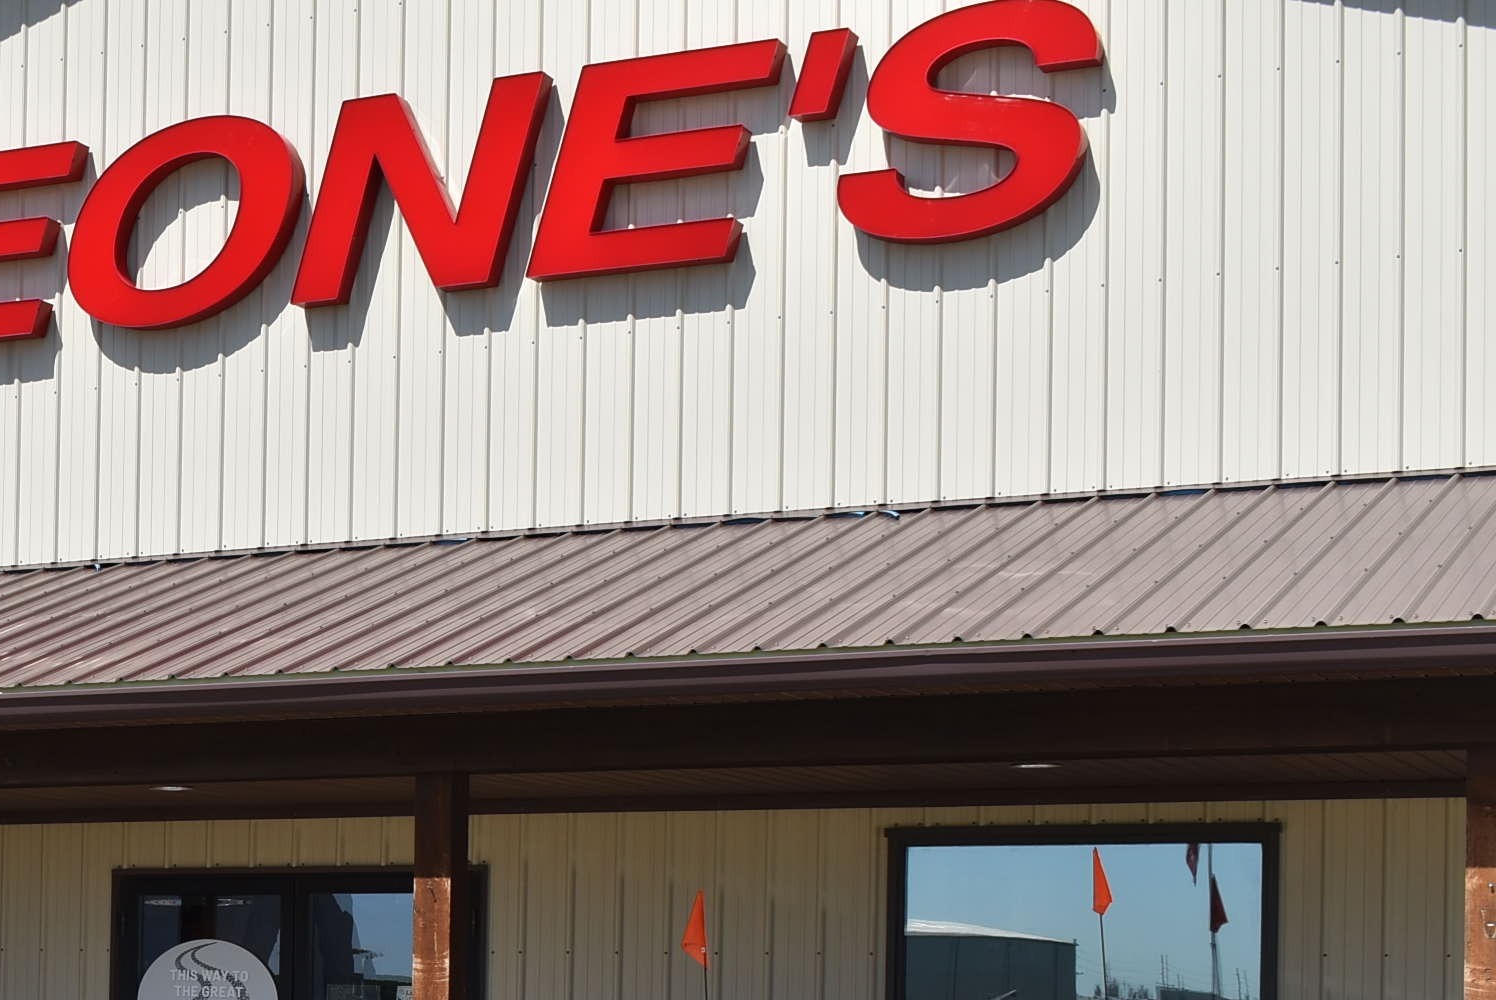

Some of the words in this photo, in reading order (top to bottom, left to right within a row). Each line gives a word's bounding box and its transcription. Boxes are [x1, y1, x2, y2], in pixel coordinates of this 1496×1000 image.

[170, 969, 198, 980] THIS
[202, 970, 229, 981] WAY
[233, 970, 249, 982] TO
[175, 985, 200, 997] THE
[202, 986, 243, 998] GREAT
